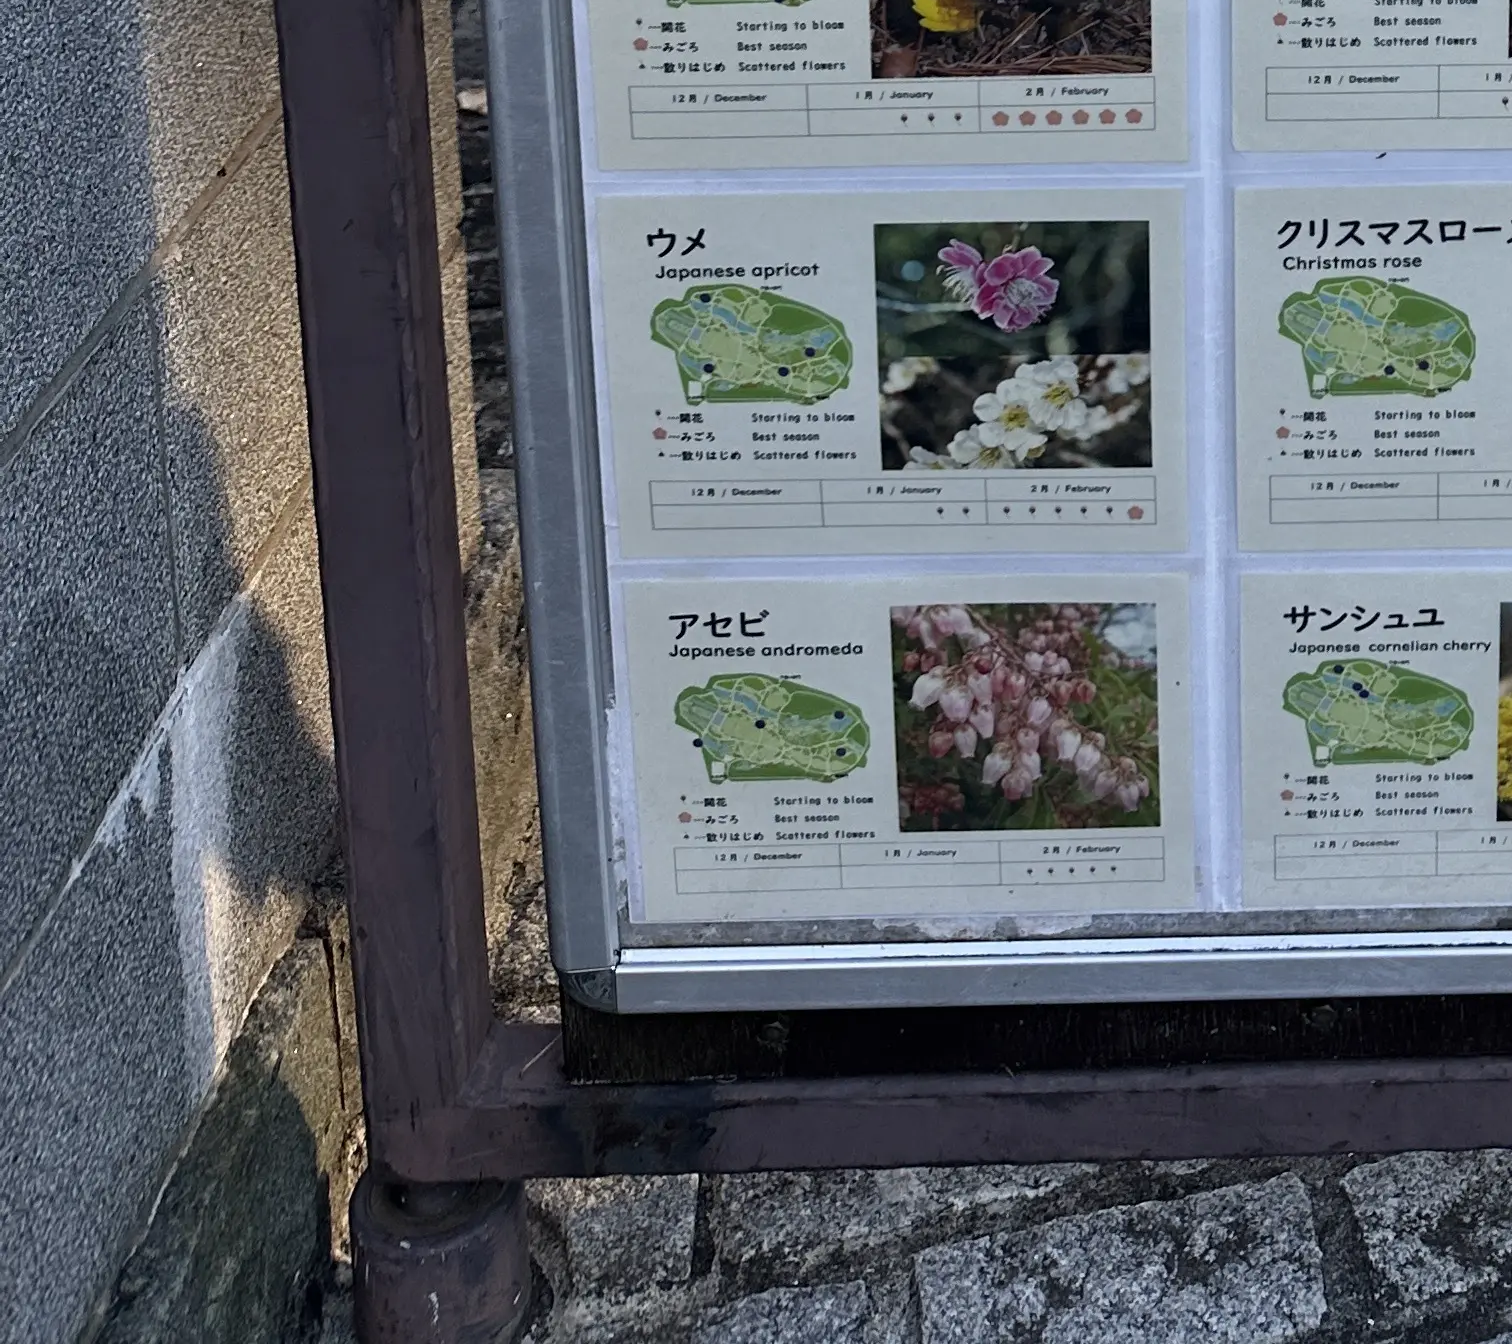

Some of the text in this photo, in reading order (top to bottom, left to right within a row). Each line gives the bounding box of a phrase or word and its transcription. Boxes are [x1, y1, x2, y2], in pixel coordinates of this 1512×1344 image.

[1373, 16, 1442, 27] Best season
[1373, 35, 1478, 47] Scattered flowers
[646, 227, 706, 258] ウメ
[654, 262, 820, 282] Japanese apricot
[1282, 255, 1423, 271] Christmas rose
[668, 609, 770, 640] アセビ
[1282, 604, 1445, 634] サンシュユ
[668, 642, 864, 661] Japanese andromeda
[1288, 639, 1492, 656] Japanese cornelian cherry
